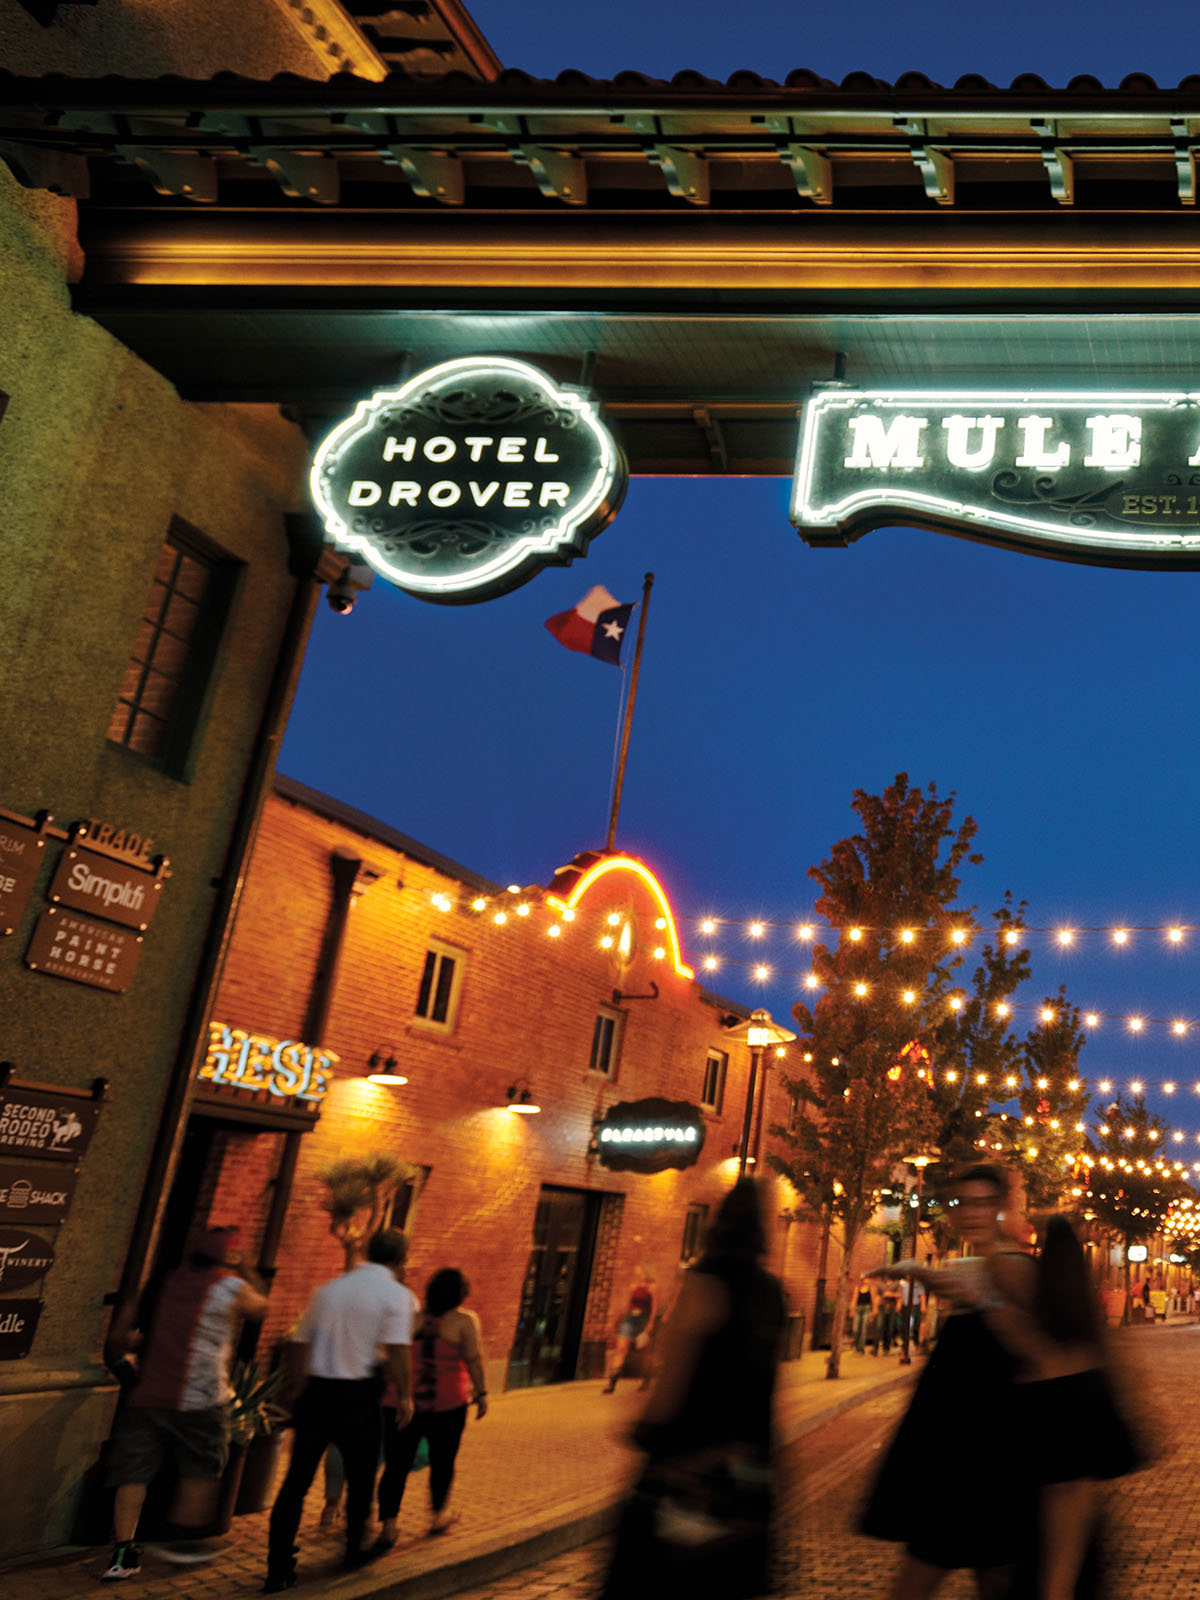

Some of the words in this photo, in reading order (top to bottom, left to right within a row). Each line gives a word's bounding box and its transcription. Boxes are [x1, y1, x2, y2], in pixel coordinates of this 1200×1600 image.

[383, 436, 559, 463] HOTEL
[844, 414, 1142, 471] MULE
[348, 480, 571, 508] DROVER
[1122, 495, 1182, 514] EST.
[83, 817, 155, 861] TRADE
[54, 930, 121, 959] PAINT
[49, 945, 117, 975] HORSE
[2, 1103, 56, 1122] SECOND
[0, 1118, 50, 1138] RODEO
[29, 1190, 68, 1205] SHACK
[7, 1258, 49, 1268] WINERY
